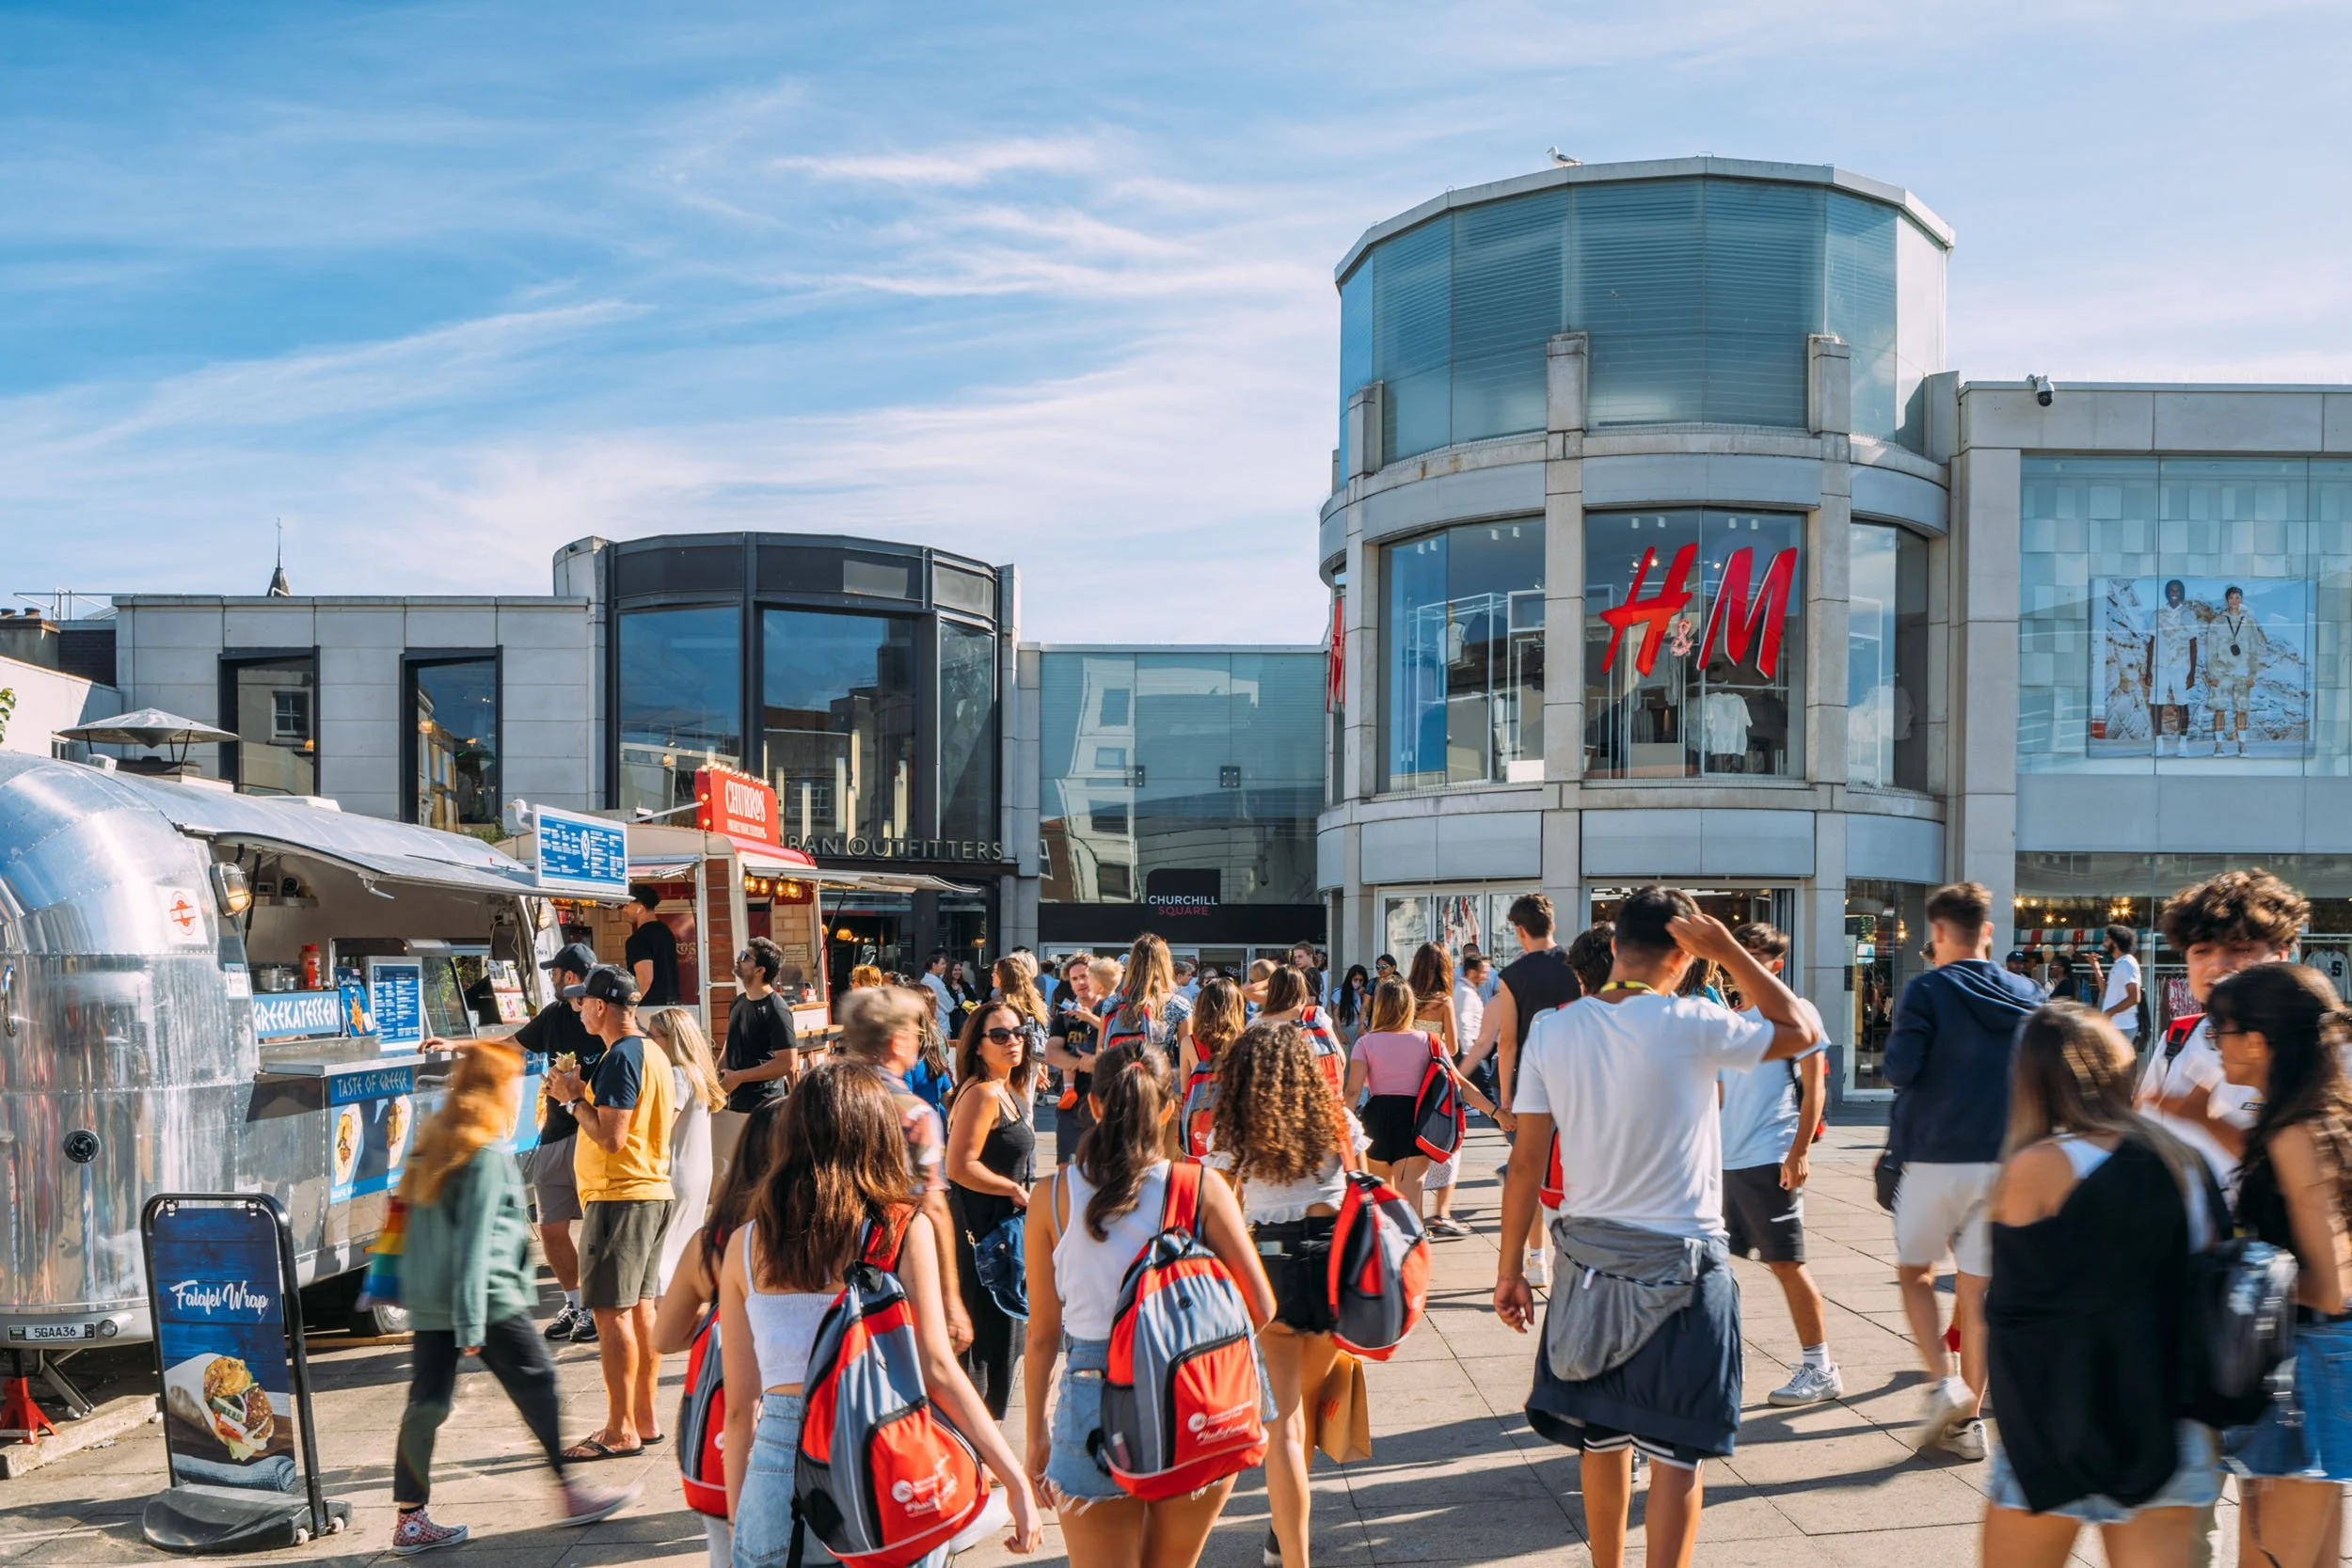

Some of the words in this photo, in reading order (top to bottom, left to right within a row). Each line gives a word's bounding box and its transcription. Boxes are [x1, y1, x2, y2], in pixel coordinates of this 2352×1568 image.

[1599, 542, 1797, 678] H&M
[725, 780, 766, 822] CHURROS
[848, 836, 1005, 861] OUTFITTERS
[1148, 895, 1218, 905] CHURCHILL
[1158, 906, 1210, 917] SQUARE
[254, 997, 340, 1032] GREEKATESSEN
[337, 1076, 362, 1098] TASTE
[364, 1074, 377, 1094] OF
[169, 1279, 221, 1315] Falafel
[222, 1279, 269, 1315] Wrap
[34, 1326, 76, 1338] 5GAA36
